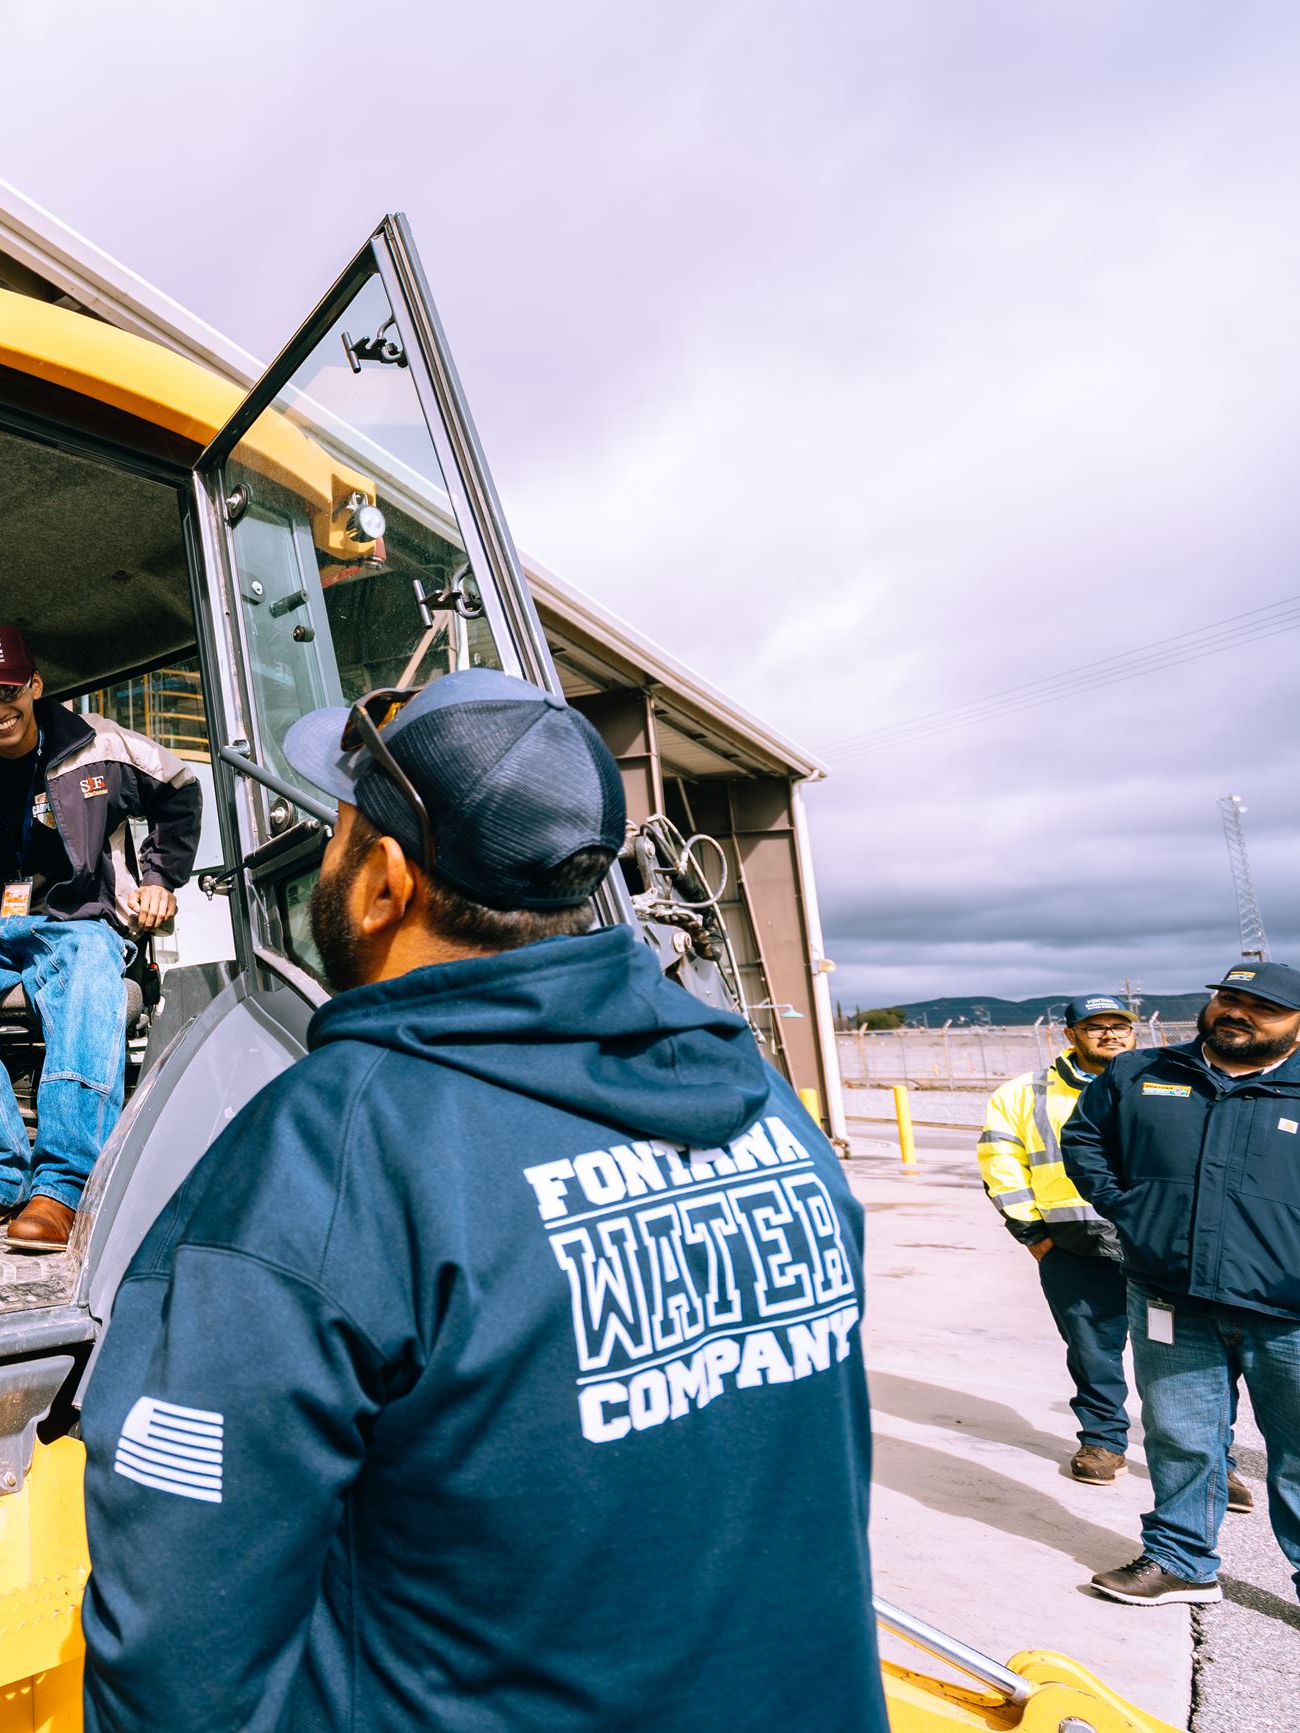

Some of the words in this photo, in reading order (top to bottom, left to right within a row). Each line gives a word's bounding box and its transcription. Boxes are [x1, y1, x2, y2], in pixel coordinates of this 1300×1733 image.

[523, 1116, 811, 1221] FONTANA
[548, 1171, 855, 1371] WATER
[578, 1306, 860, 1443] COMPANY
